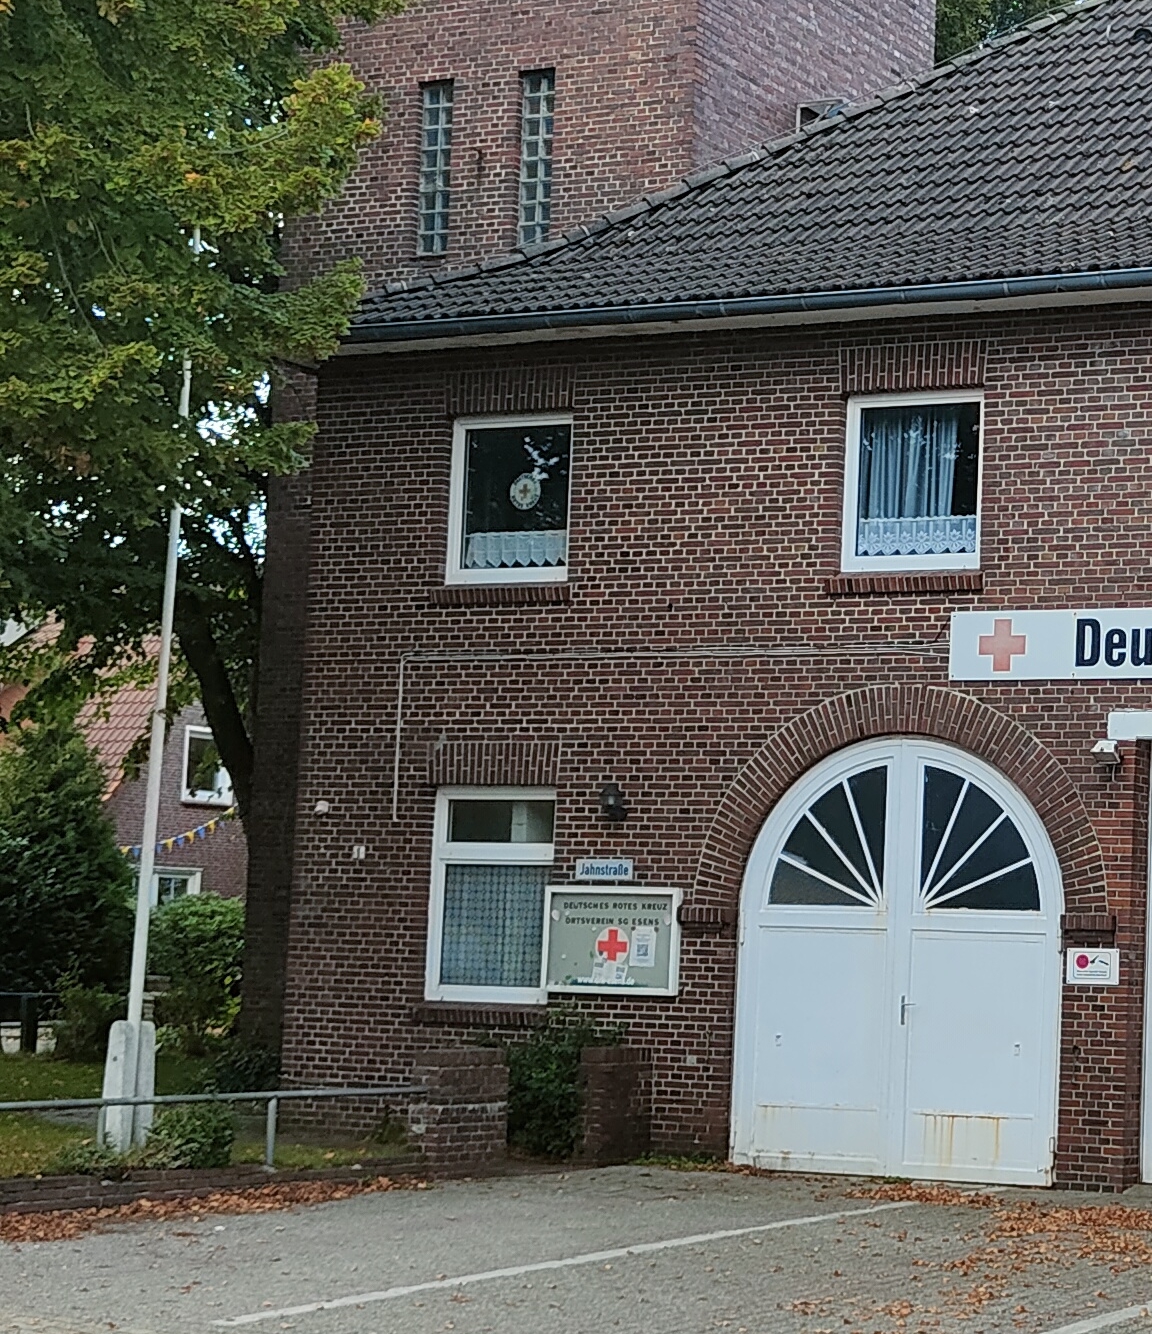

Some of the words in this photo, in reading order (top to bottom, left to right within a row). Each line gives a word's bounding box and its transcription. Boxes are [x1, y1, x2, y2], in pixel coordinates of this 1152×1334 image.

[580, 863, 629, 875] Jahnstraße
[563, 901, 609, 910] DEUTSCHES
[612, 902, 638, 911] ROTES
[641, 903, 668, 911] KREUZ
[565, 916, 614, 925] ORTSVEREIN
[617, 917, 629, 925] SG
[631, 918, 660, 926] ESENS
